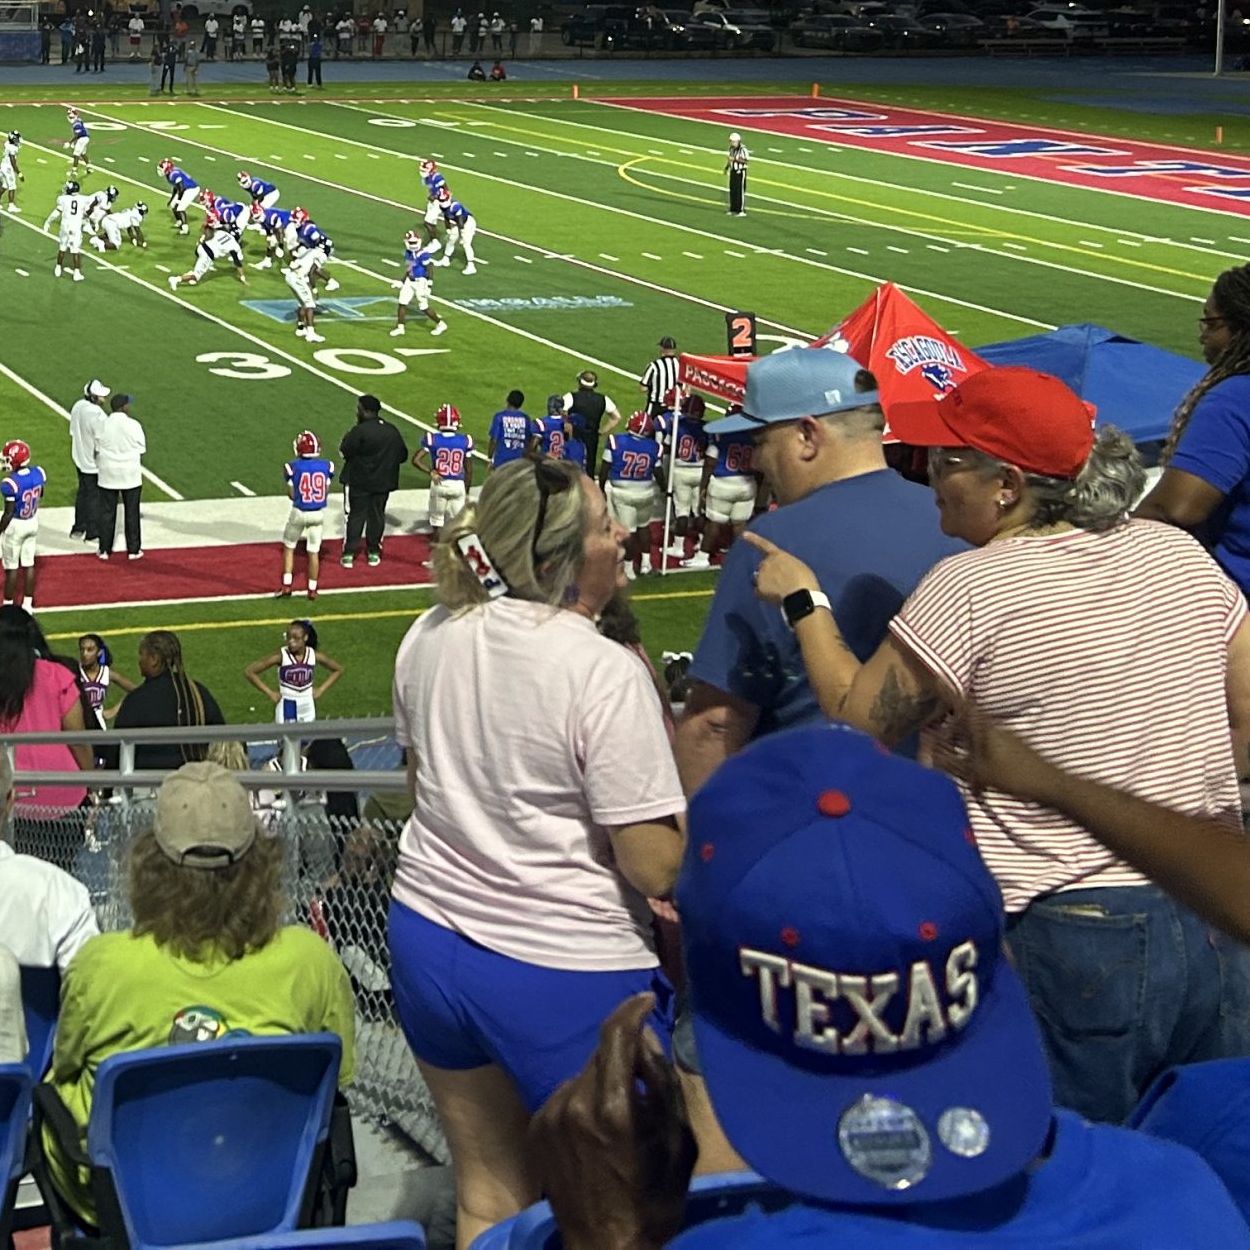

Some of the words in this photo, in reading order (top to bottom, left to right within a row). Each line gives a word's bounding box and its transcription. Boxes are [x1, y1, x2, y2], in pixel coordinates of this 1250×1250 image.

[70, 200, 78, 216] 9
[732, 317, 752, 347] 2
[436, 448, 464, 476] 28
[620, 451, 650, 479] 72
[299, 472, 326, 503] 49
[739, 940, 979, 1055] TEXAS
